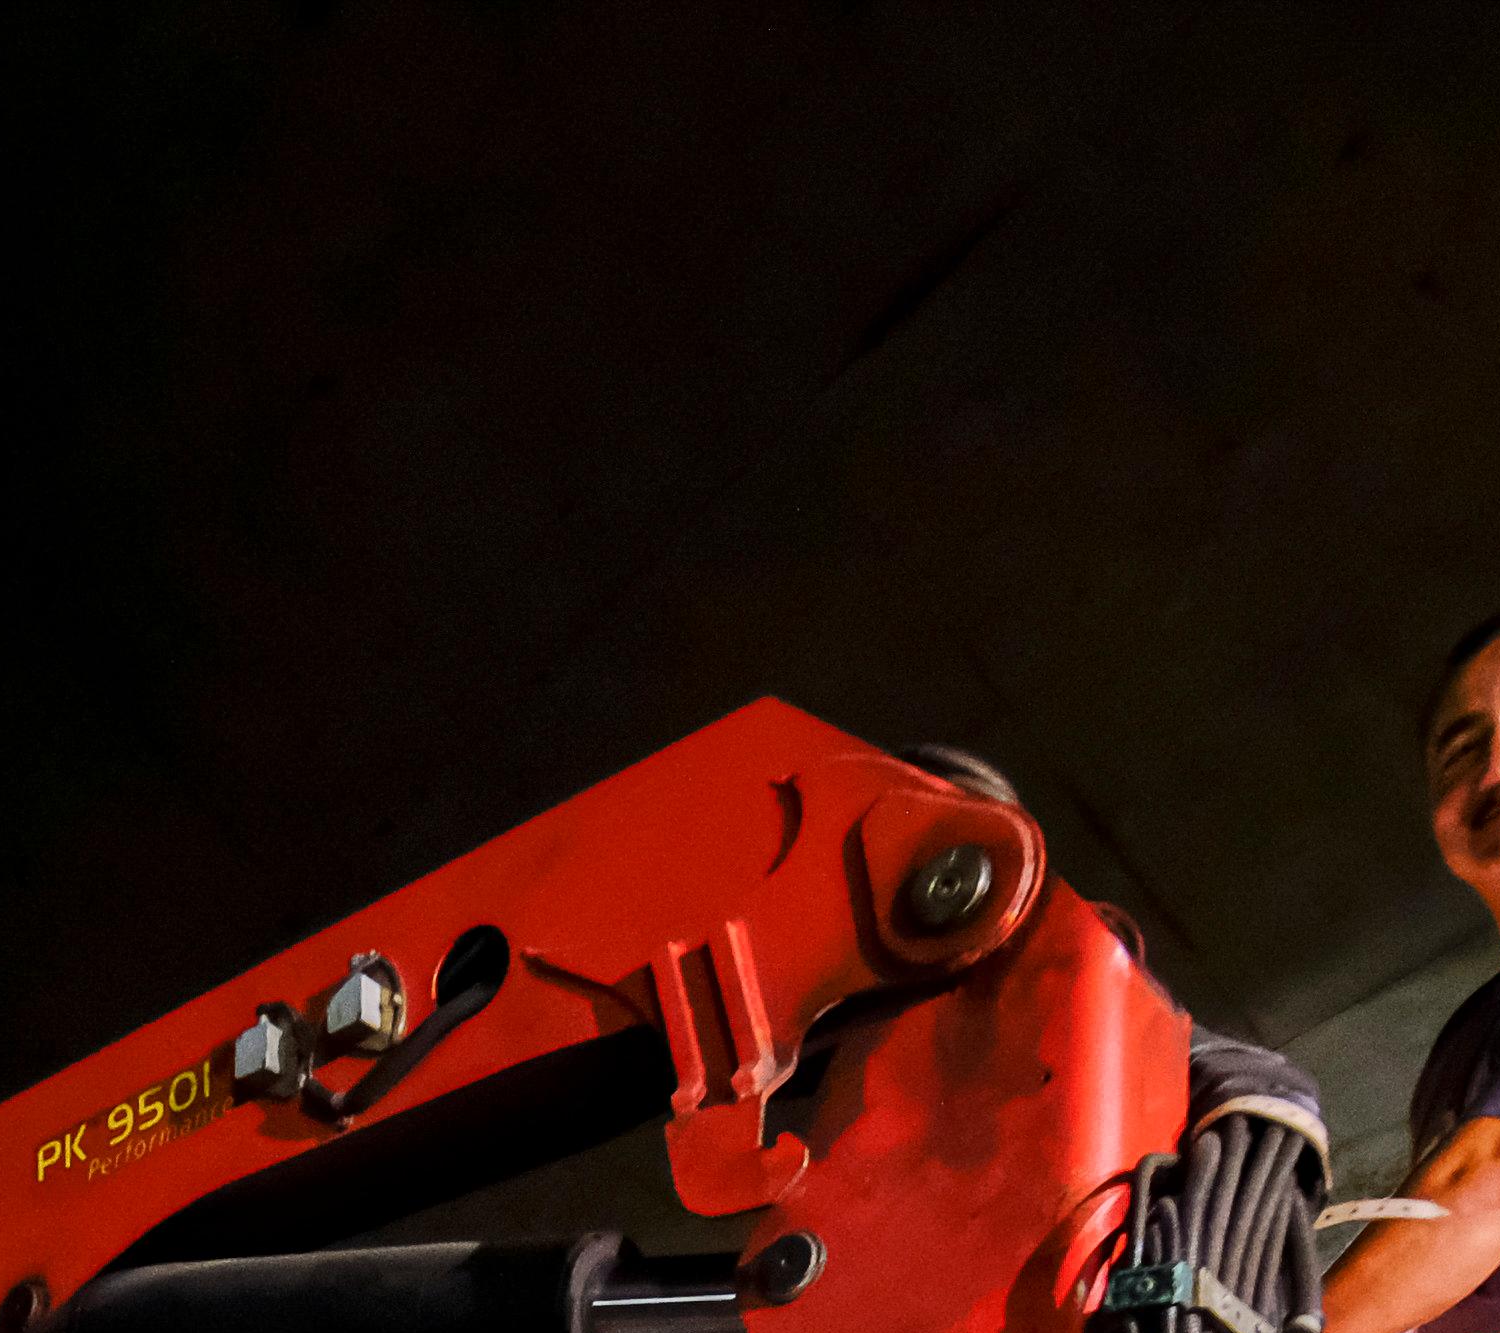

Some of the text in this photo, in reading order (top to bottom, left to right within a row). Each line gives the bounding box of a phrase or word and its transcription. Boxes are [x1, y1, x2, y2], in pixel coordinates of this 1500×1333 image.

[37, 1059, 211, 1182] PK 9501
[88, 1096, 234, 1181] Performance
